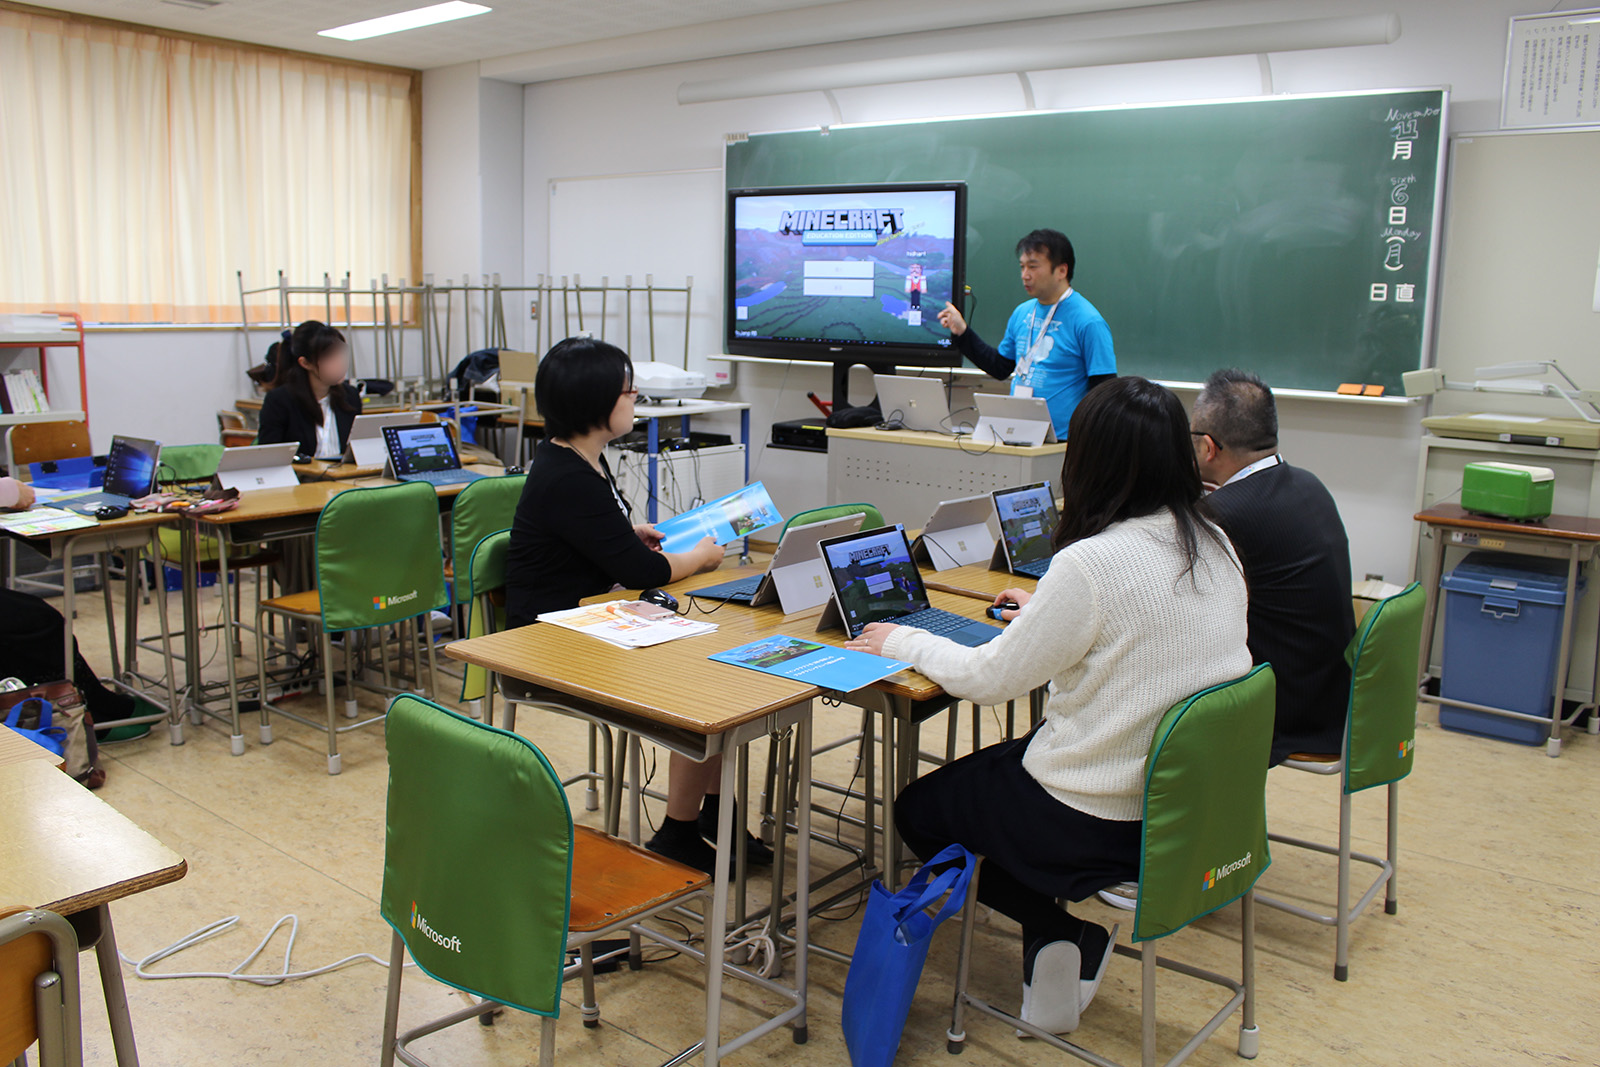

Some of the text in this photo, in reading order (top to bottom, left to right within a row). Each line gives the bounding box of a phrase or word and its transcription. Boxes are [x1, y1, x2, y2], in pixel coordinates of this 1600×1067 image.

[779, 208, 905, 235] MINECRAFT
[805, 232, 844, 240] EDUCATION
[848, 544, 892, 563] MINECRAFT
[387, 589, 418, 606] Microsoft
[1216, 851, 1252, 881] Microsoft
[416, 913, 462, 953] Microsoft
